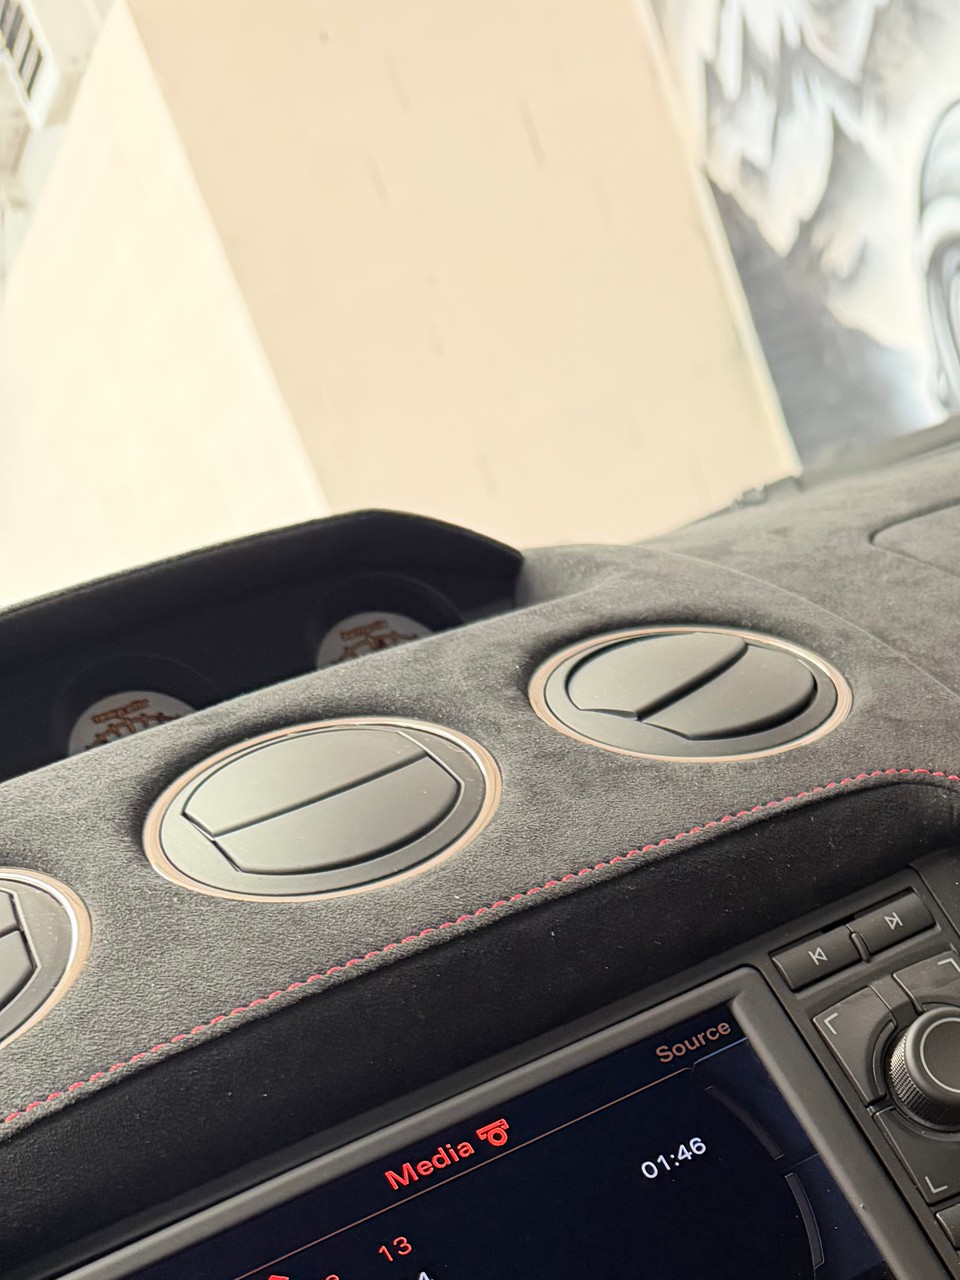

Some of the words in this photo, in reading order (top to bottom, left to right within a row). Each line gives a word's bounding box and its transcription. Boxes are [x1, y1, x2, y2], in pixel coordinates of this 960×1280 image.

[656, 1020, 732, 1062] Source
[385, 1138, 475, 1191] Media
[640, 1135, 707, 1180] 01:46
[377, 1236, 413, 1262] 13
